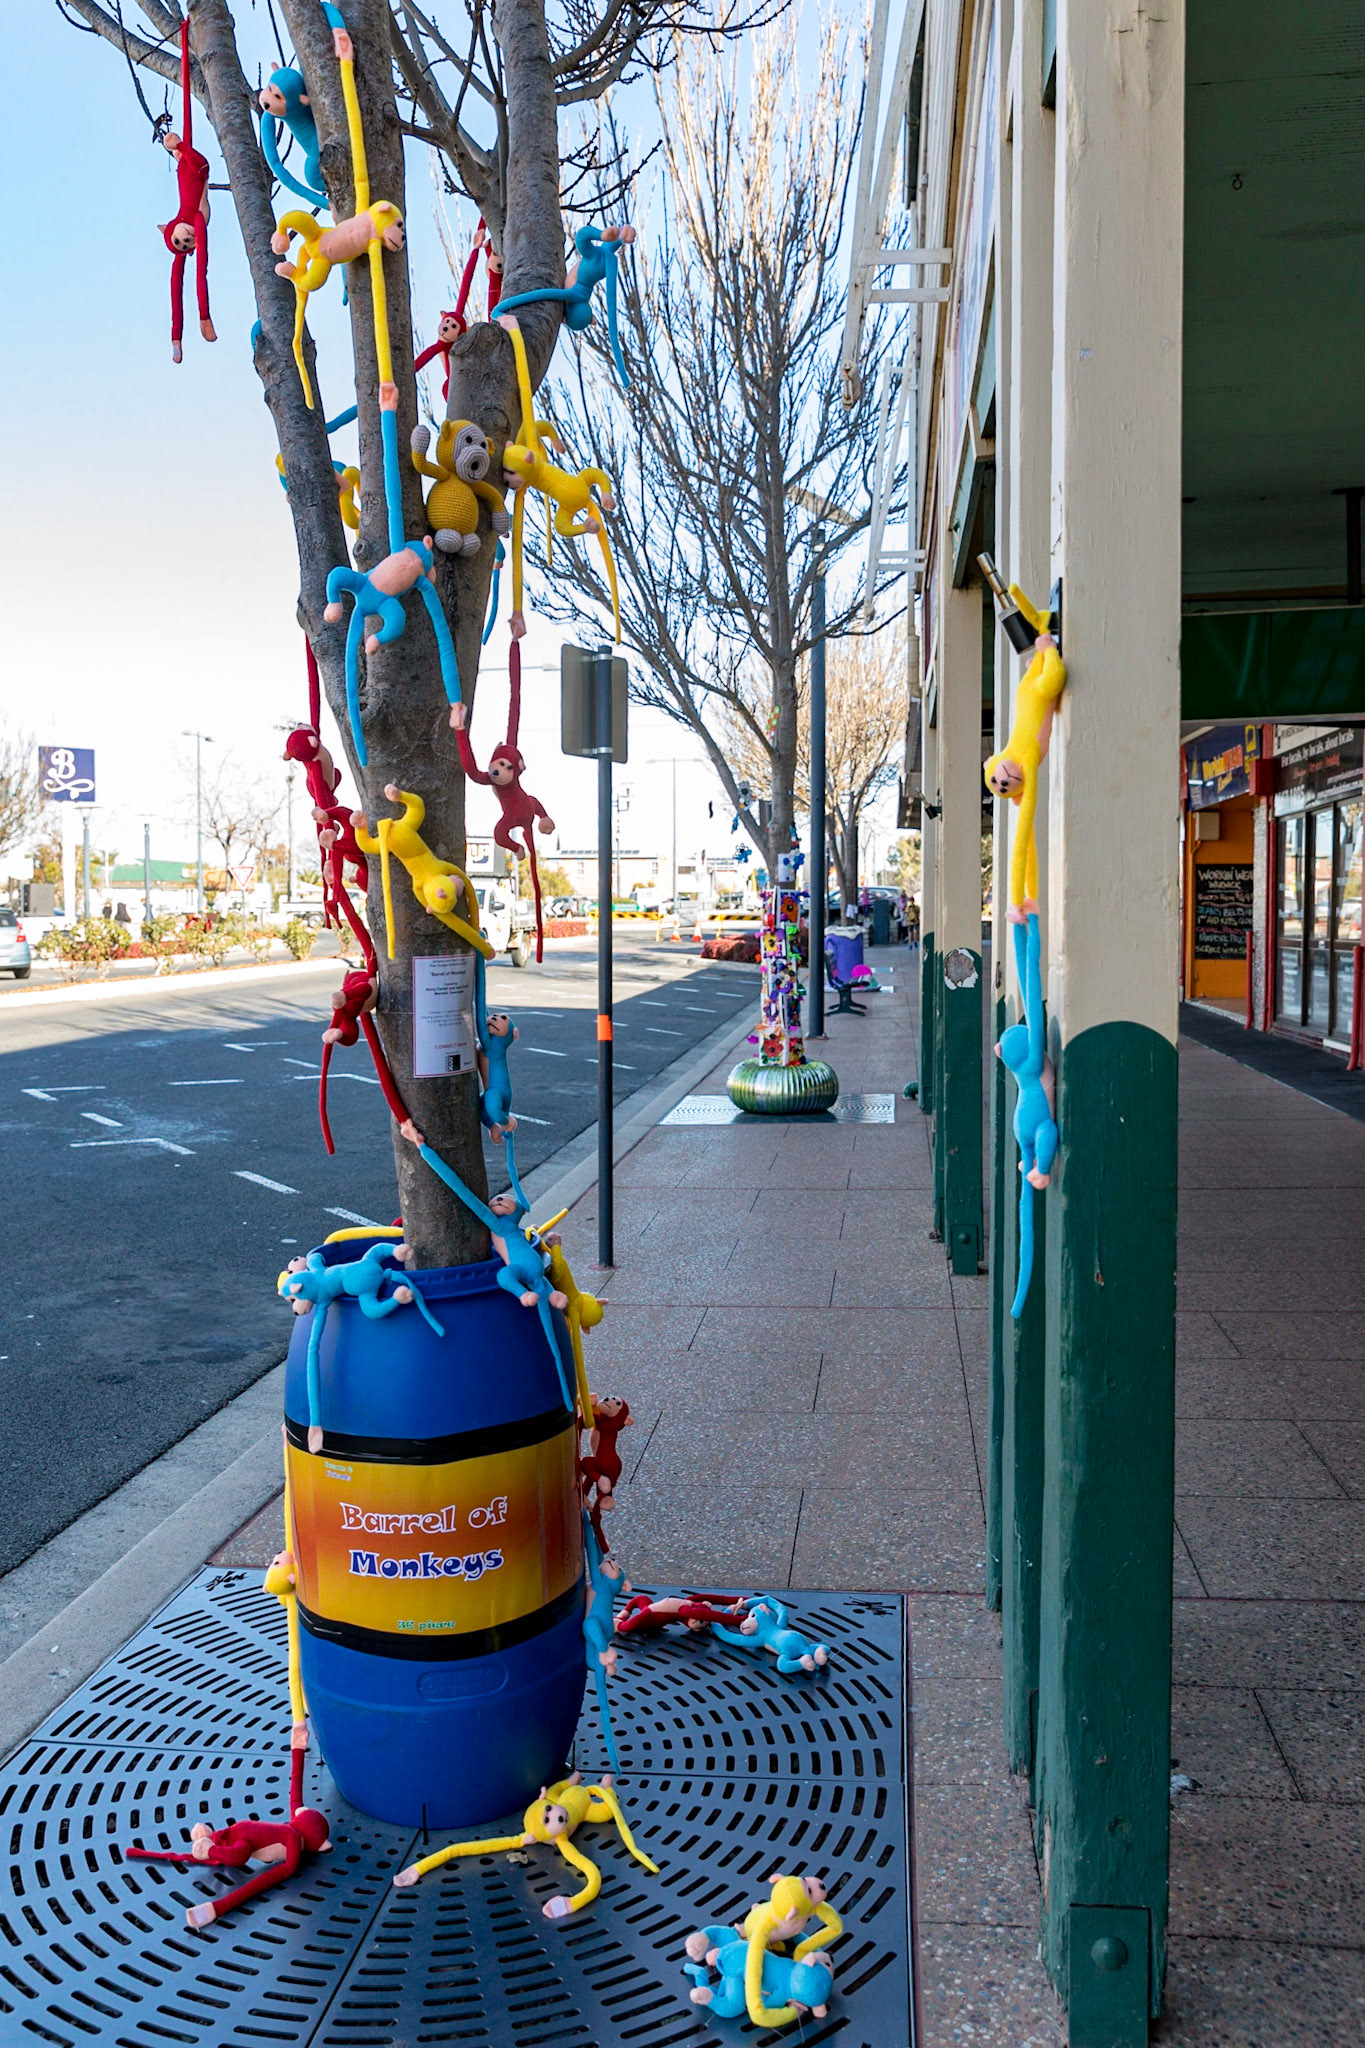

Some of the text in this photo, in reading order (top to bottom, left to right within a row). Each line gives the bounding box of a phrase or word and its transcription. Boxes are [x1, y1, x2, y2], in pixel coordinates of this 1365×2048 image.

[1325, 736, 1338, 751] about
[1339, 728, 1354, 745] locals
[1235, 868, 1253, 880] WEA
[339, 1496, 508, 1534] Barrel of
[349, 1549, 504, 1582] Monkeys
